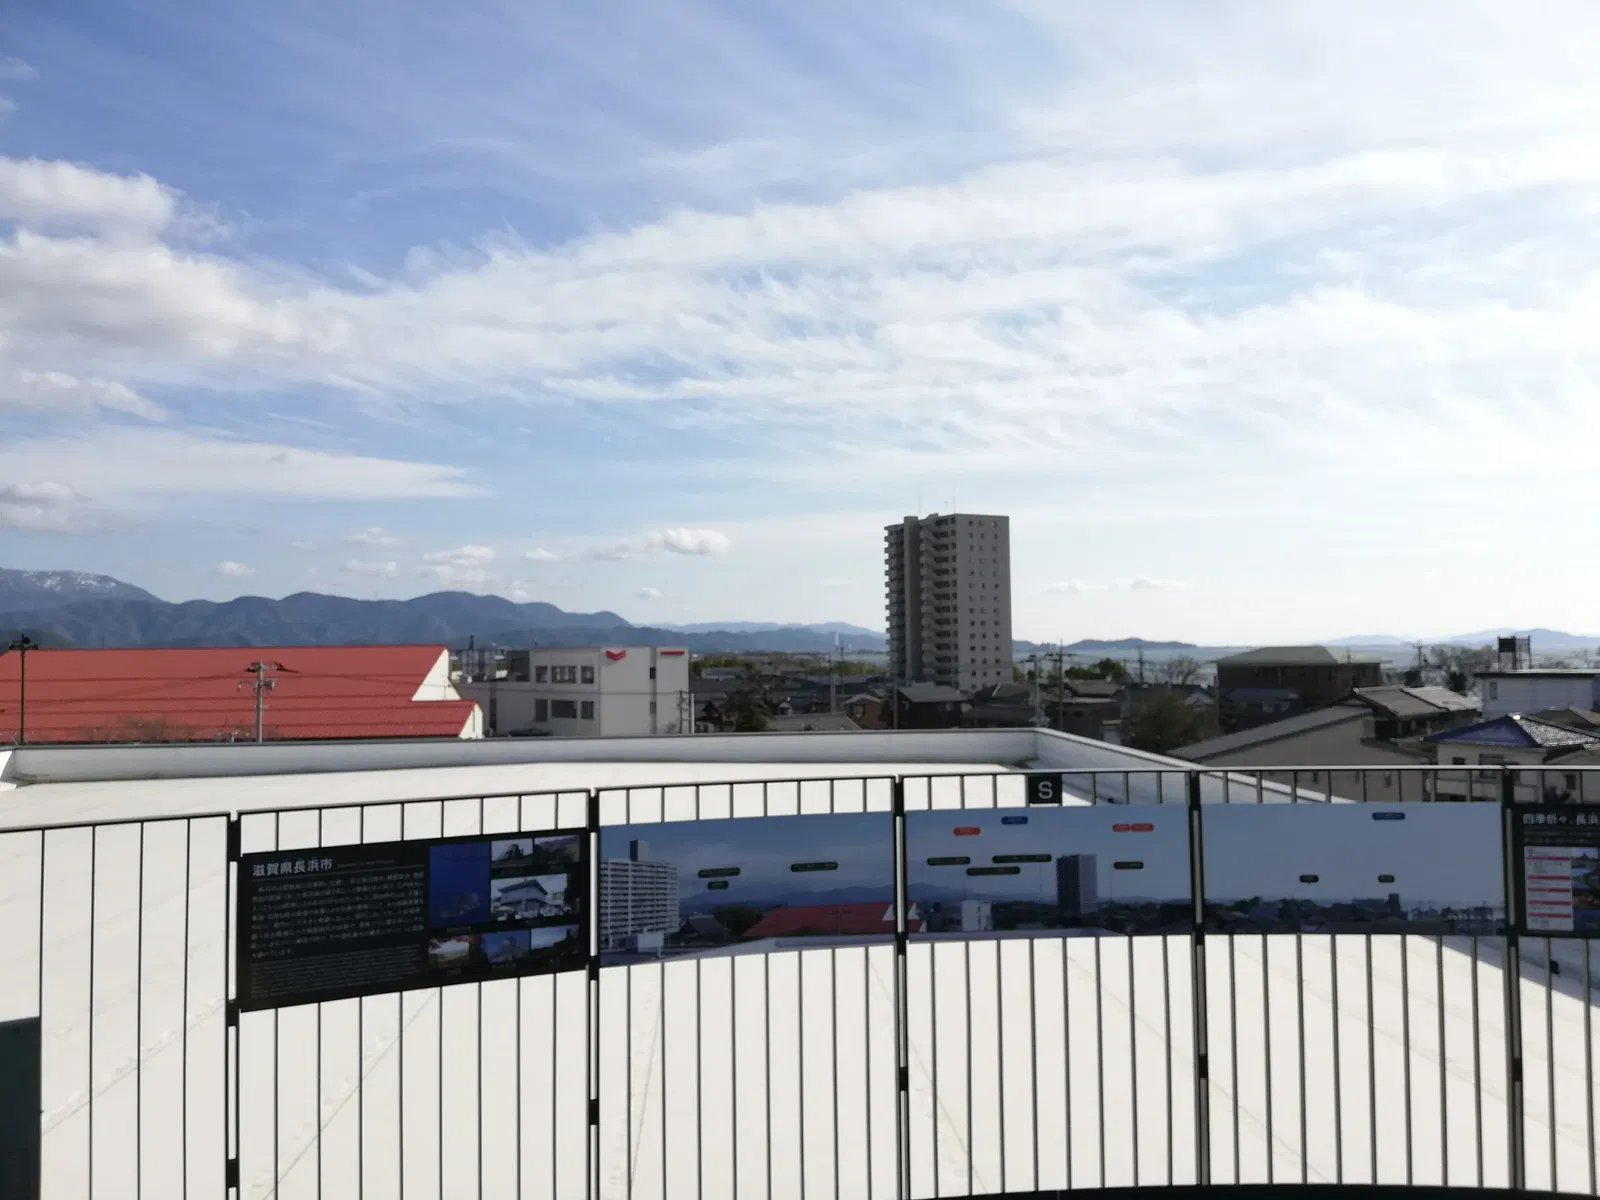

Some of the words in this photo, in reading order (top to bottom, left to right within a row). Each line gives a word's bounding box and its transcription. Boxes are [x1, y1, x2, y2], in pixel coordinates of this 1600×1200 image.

[1038, 781, 1053, 799] S
[252, 858, 333, 877] 滋賀県長浜市
